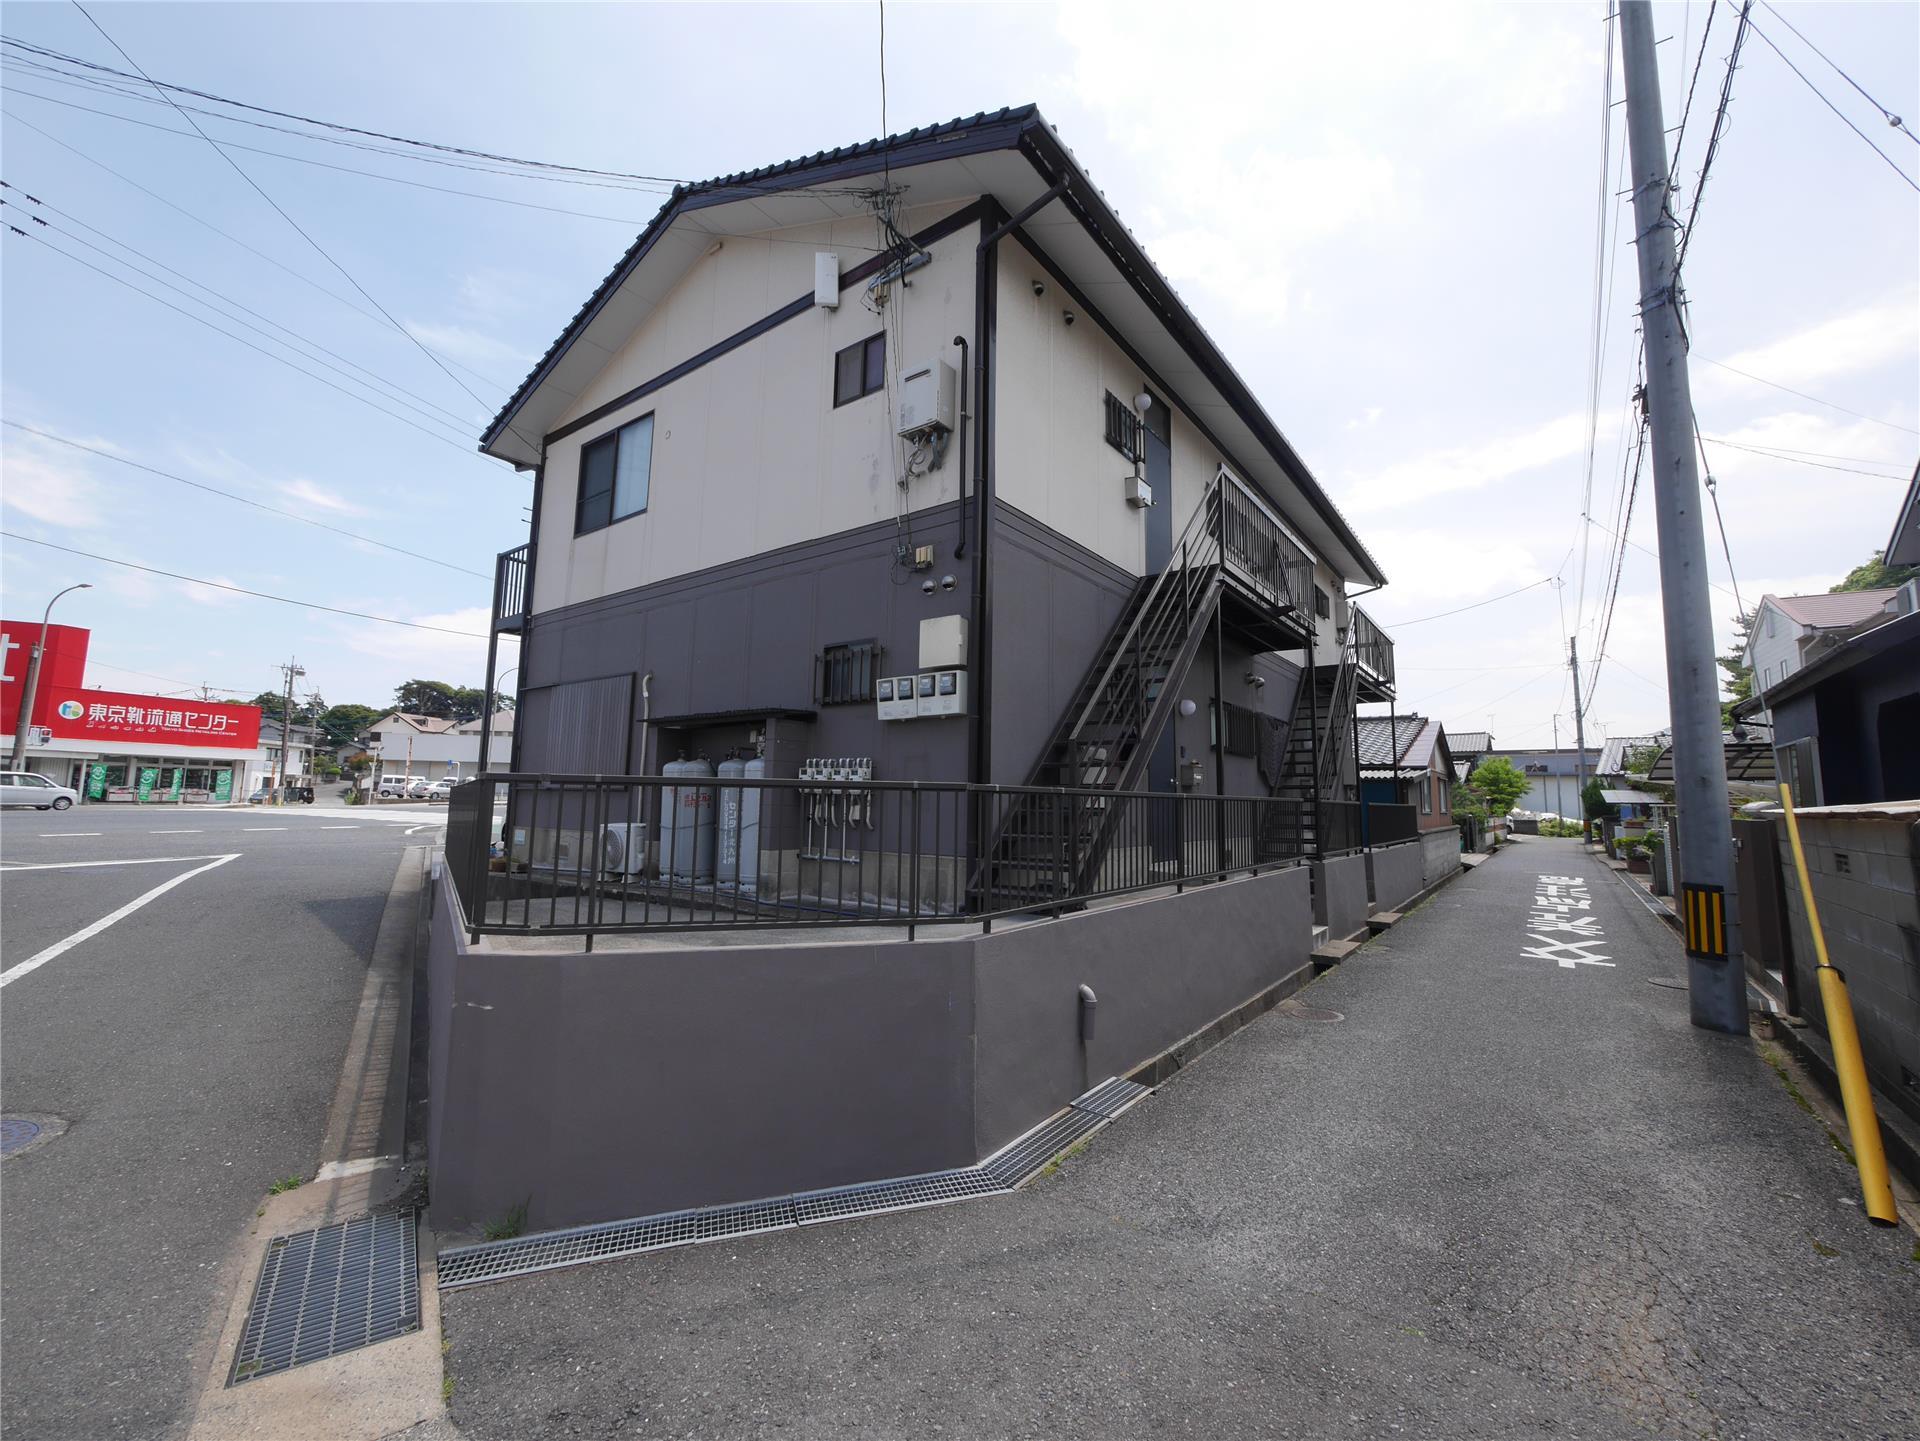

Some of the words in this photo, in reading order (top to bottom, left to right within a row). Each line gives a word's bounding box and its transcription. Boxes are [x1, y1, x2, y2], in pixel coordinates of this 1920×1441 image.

[88, 703, 239, 731] 東京靴流通センター
